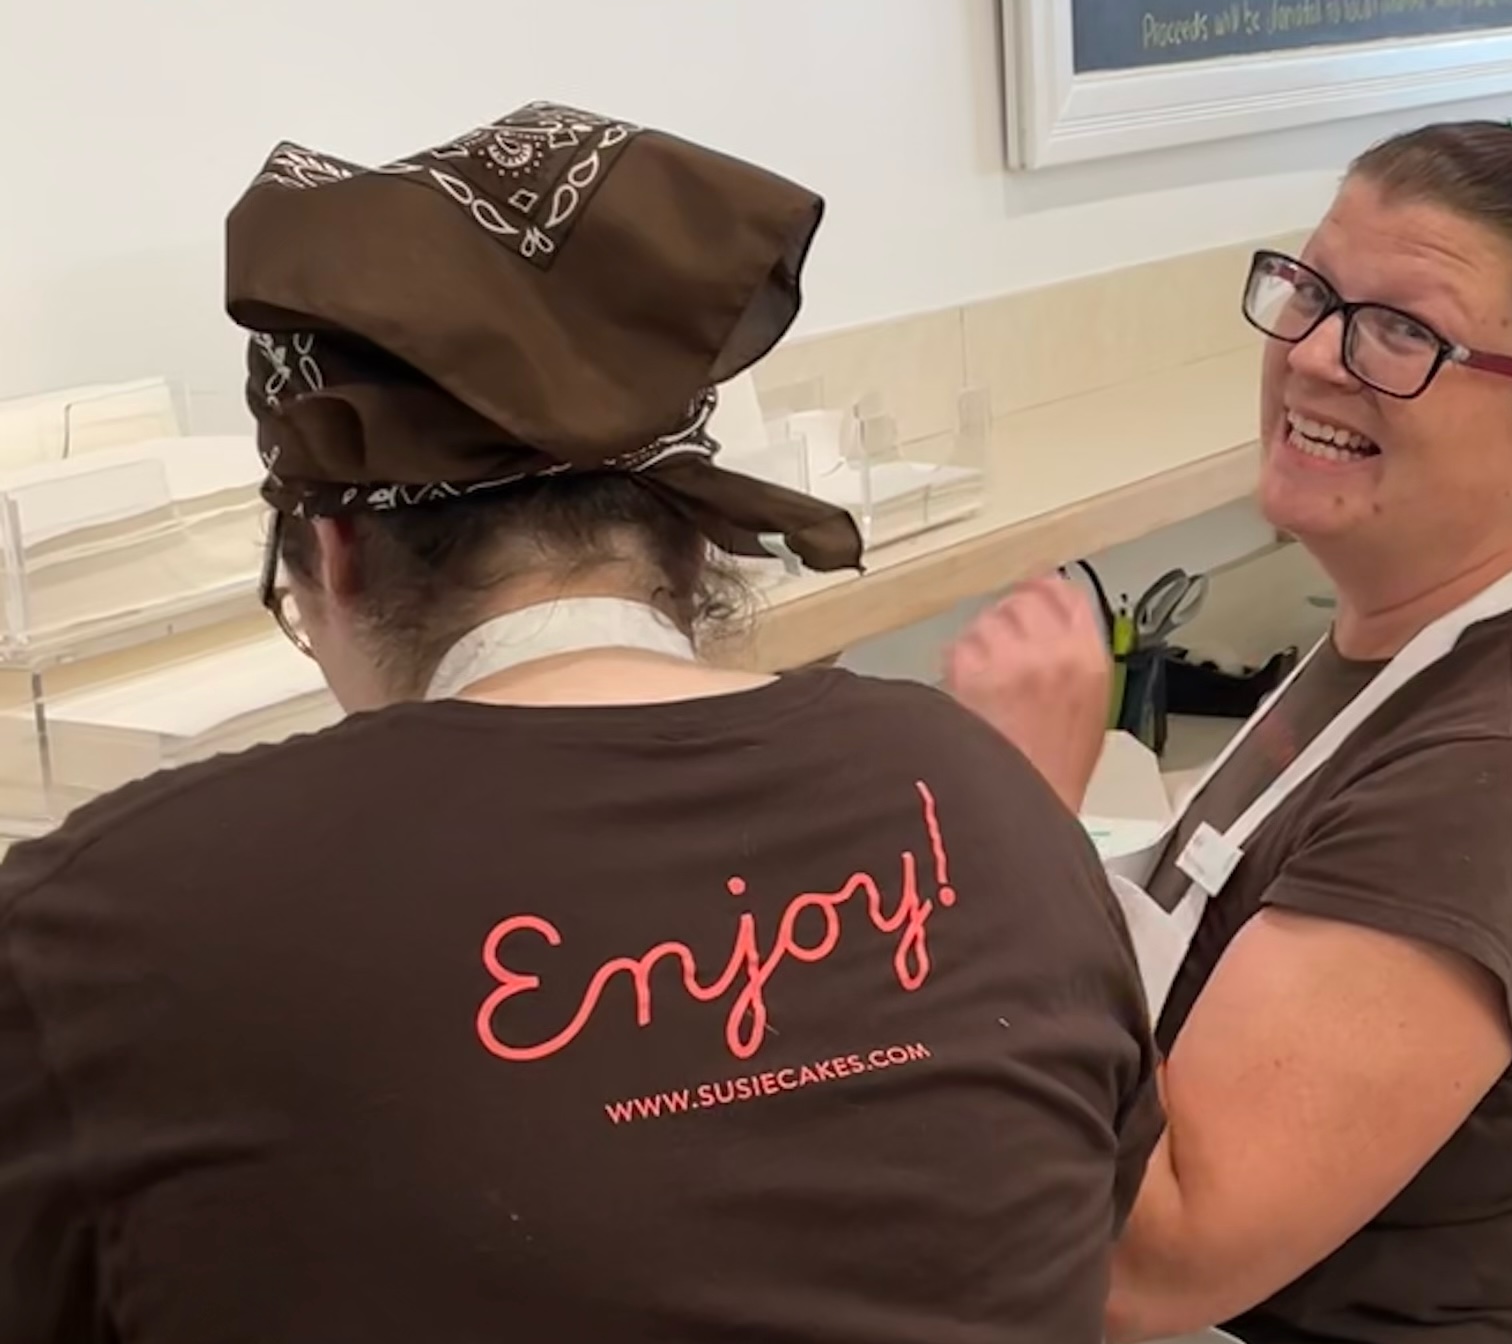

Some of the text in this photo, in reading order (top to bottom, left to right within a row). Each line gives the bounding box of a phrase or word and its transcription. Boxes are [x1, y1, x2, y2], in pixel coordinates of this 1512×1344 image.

[1142, 10, 1208, 49] Proceeds
[475, 780, 957, 1061] Enjoy!
[605, 1042, 931, 1125] WWW.SUSIECAKES.COM
